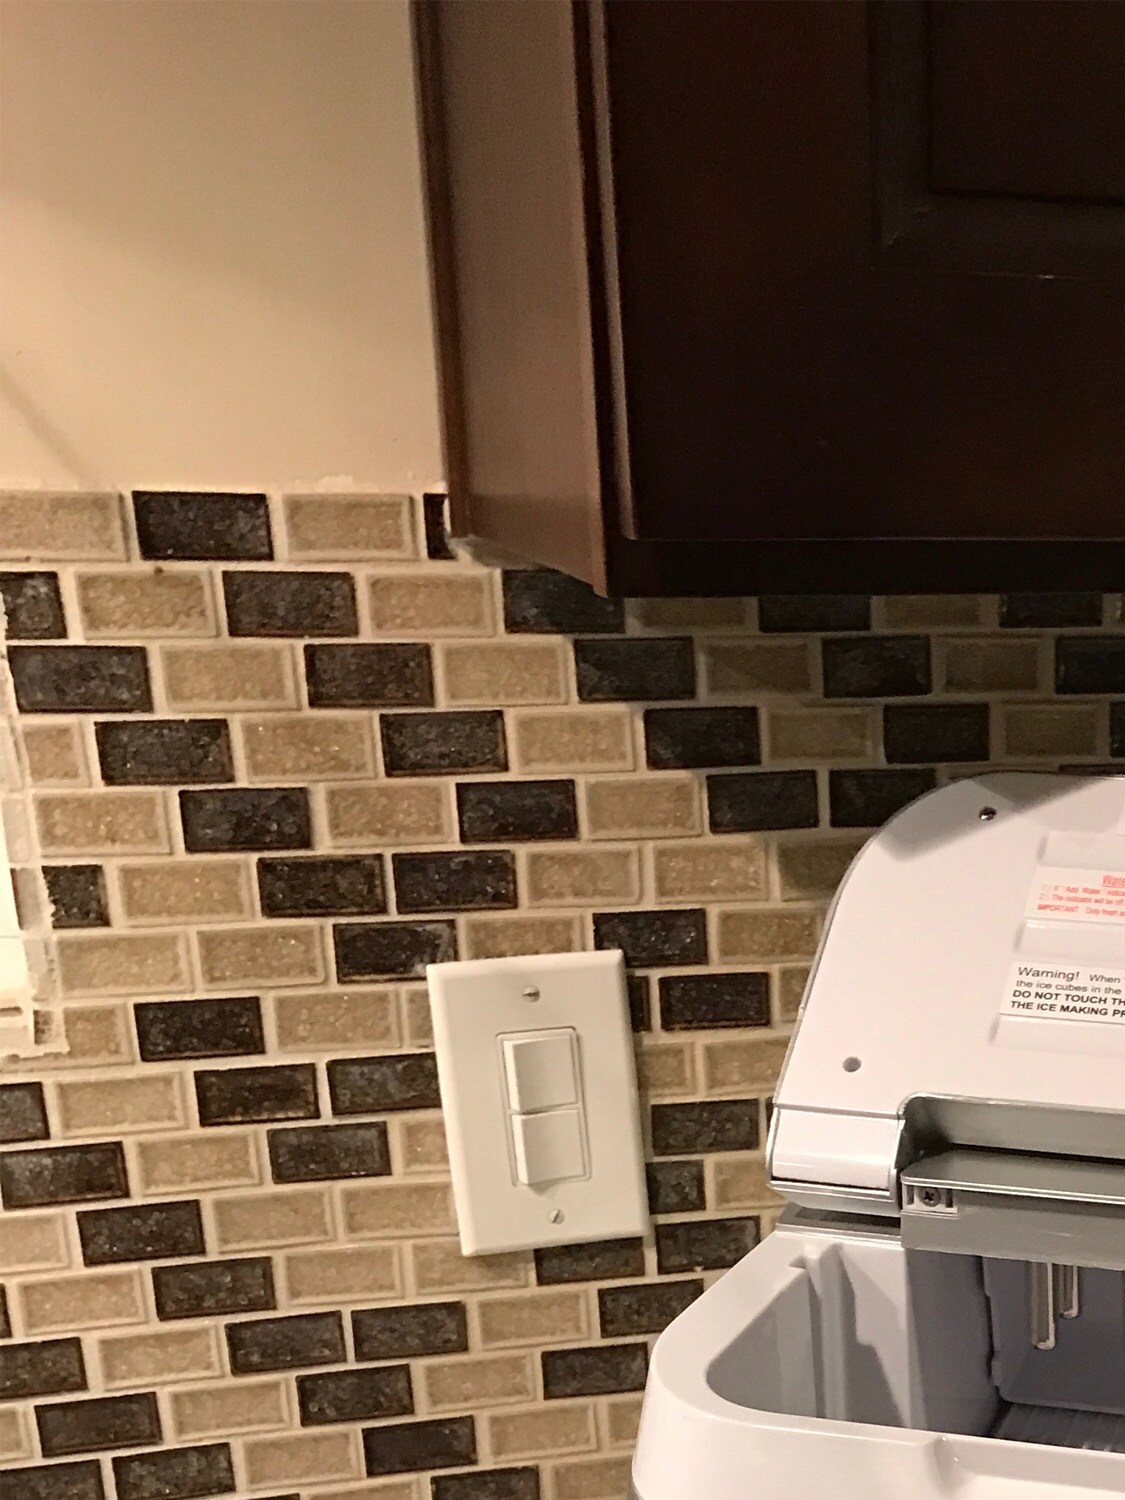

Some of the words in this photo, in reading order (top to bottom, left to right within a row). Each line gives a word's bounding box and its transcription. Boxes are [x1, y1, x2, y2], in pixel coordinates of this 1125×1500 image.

[1018, 966, 1080, 982] Warning!
[1089, 974, 1121, 984] When
[1015, 979, 1033, 988] the
[1055, 983, 1088, 992] cubes
[1104, 986, 1122, 995] the
[1012, 990, 1032, 999] DO
[1034, 991, 1062, 1001] NOT
[1064, 993, 1108, 1005] TOUCH
[1010, 1000, 1034, 1010] THE
[1036, 1002, 1057, 1012] ICE
[1059, 1004, 1109, 1016] MAKING
